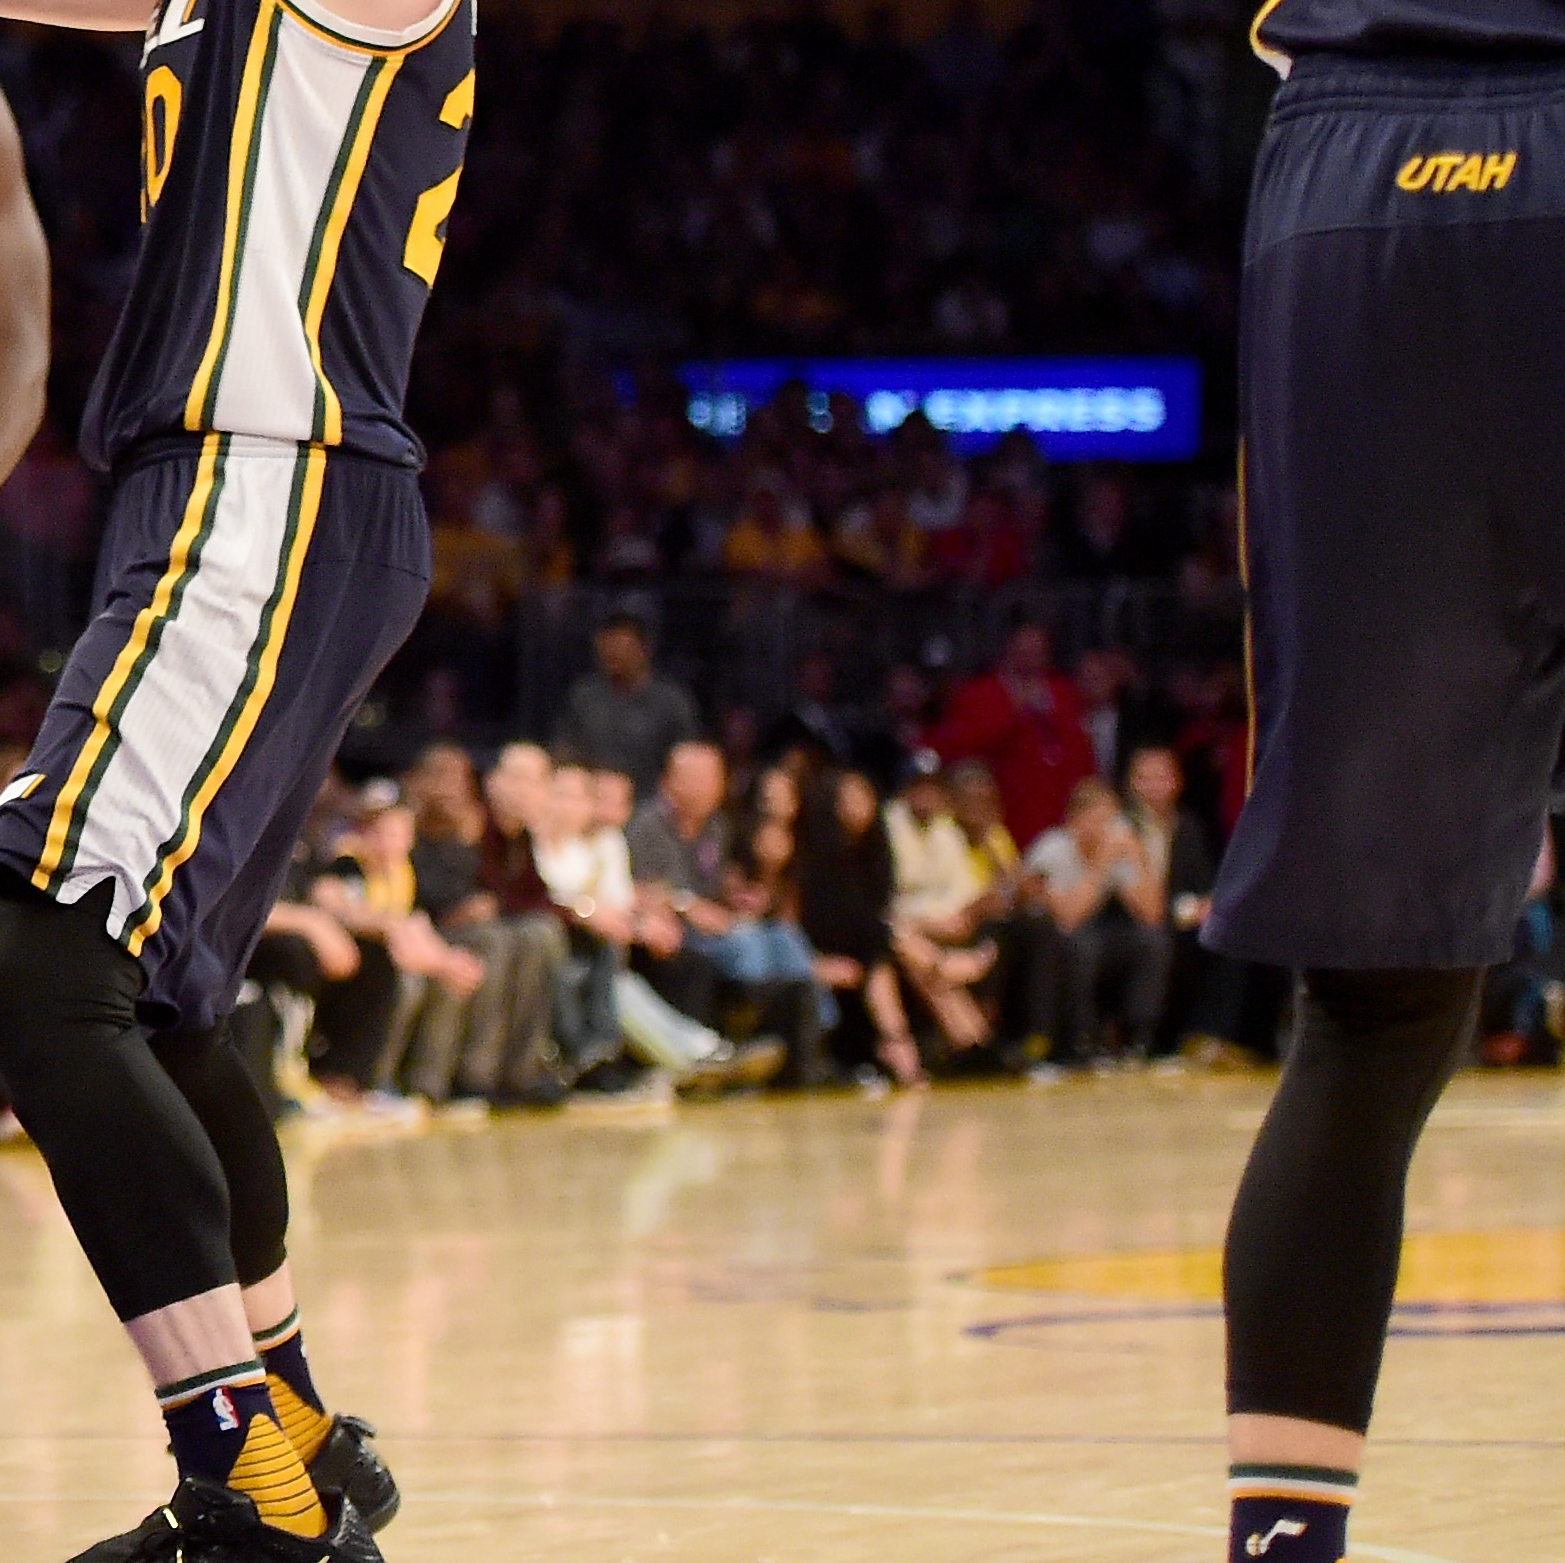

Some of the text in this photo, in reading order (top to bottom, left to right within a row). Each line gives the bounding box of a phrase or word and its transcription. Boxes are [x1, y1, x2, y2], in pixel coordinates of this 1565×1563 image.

[140, 65, 183, 224] 0
[402, 68, 476, 290] 2
[1395, 151, 1519, 193] UTAH
